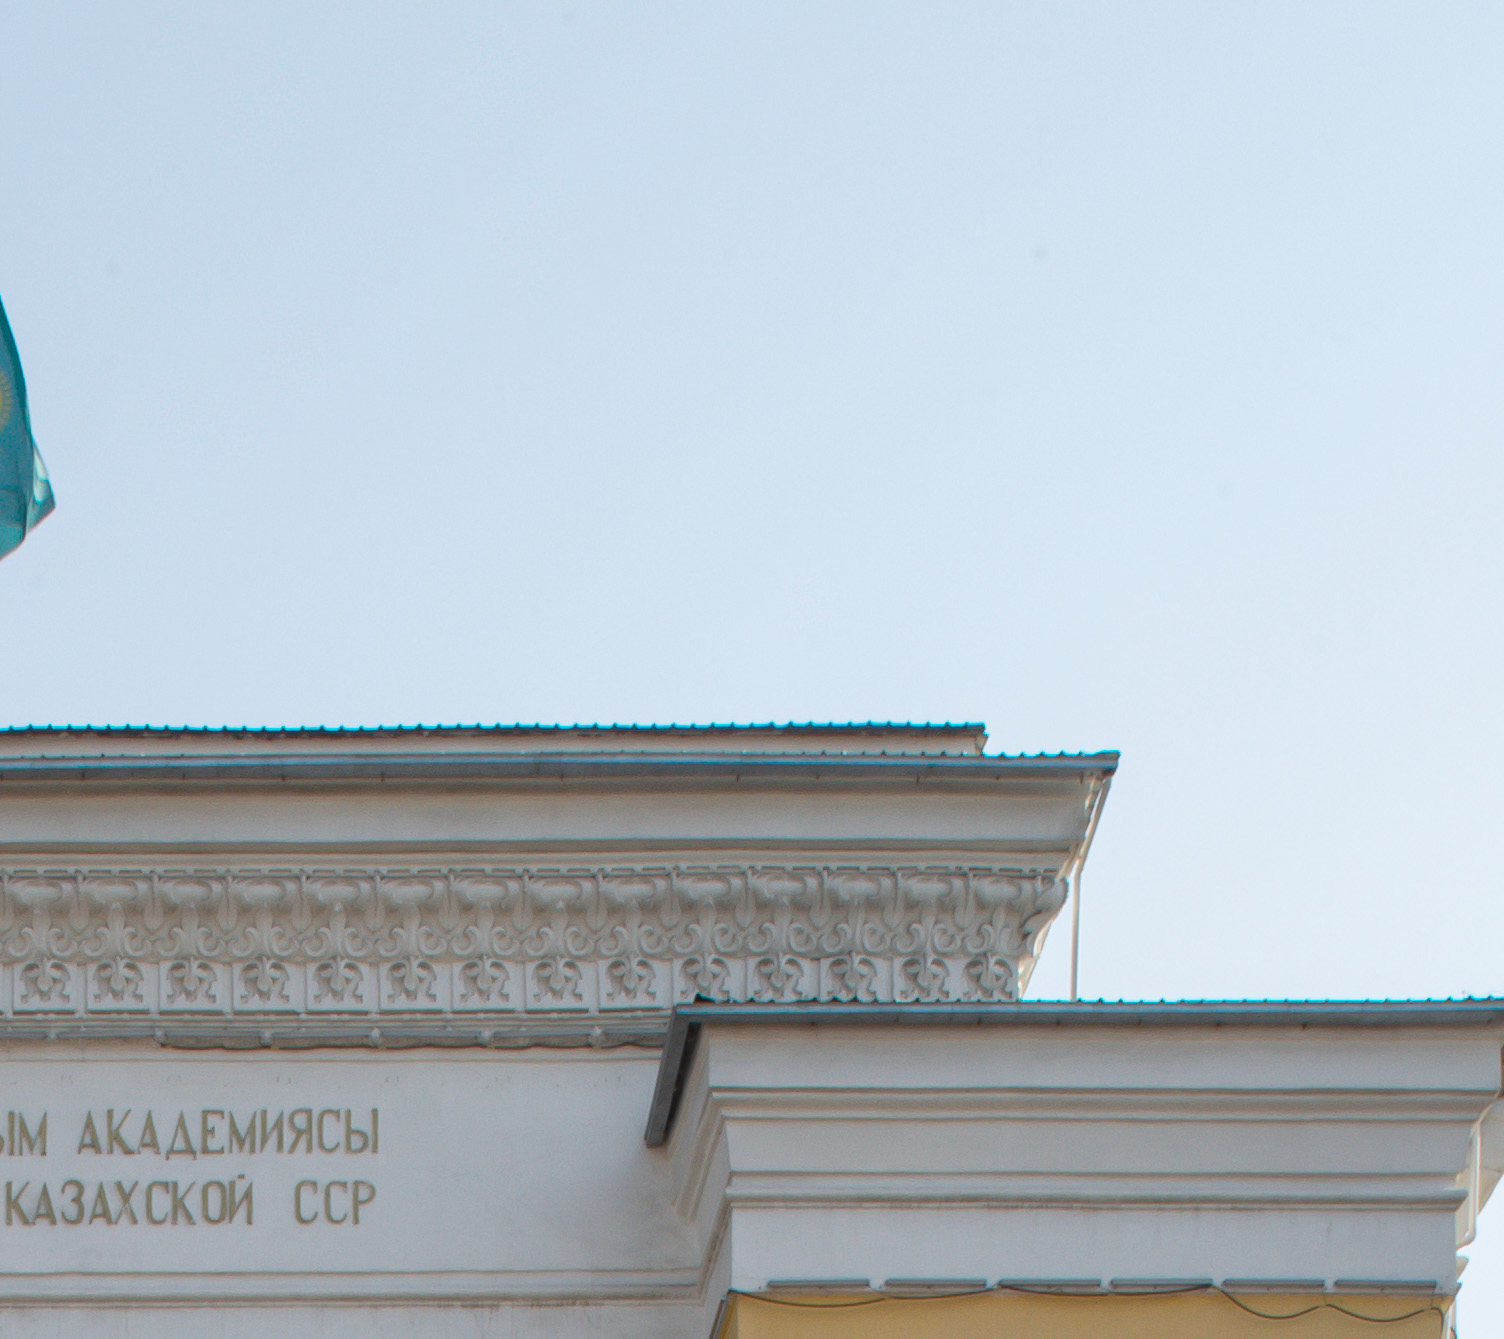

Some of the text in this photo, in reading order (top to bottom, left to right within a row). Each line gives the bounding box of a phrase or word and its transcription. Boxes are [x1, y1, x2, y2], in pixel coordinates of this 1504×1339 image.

[77, 1108, 379, 1161] АКАДЕМИЯСЫ
[4, 1174, 253, 1226] КАЗАХСКОЙ
[294, 1179, 376, 1226] ССР
